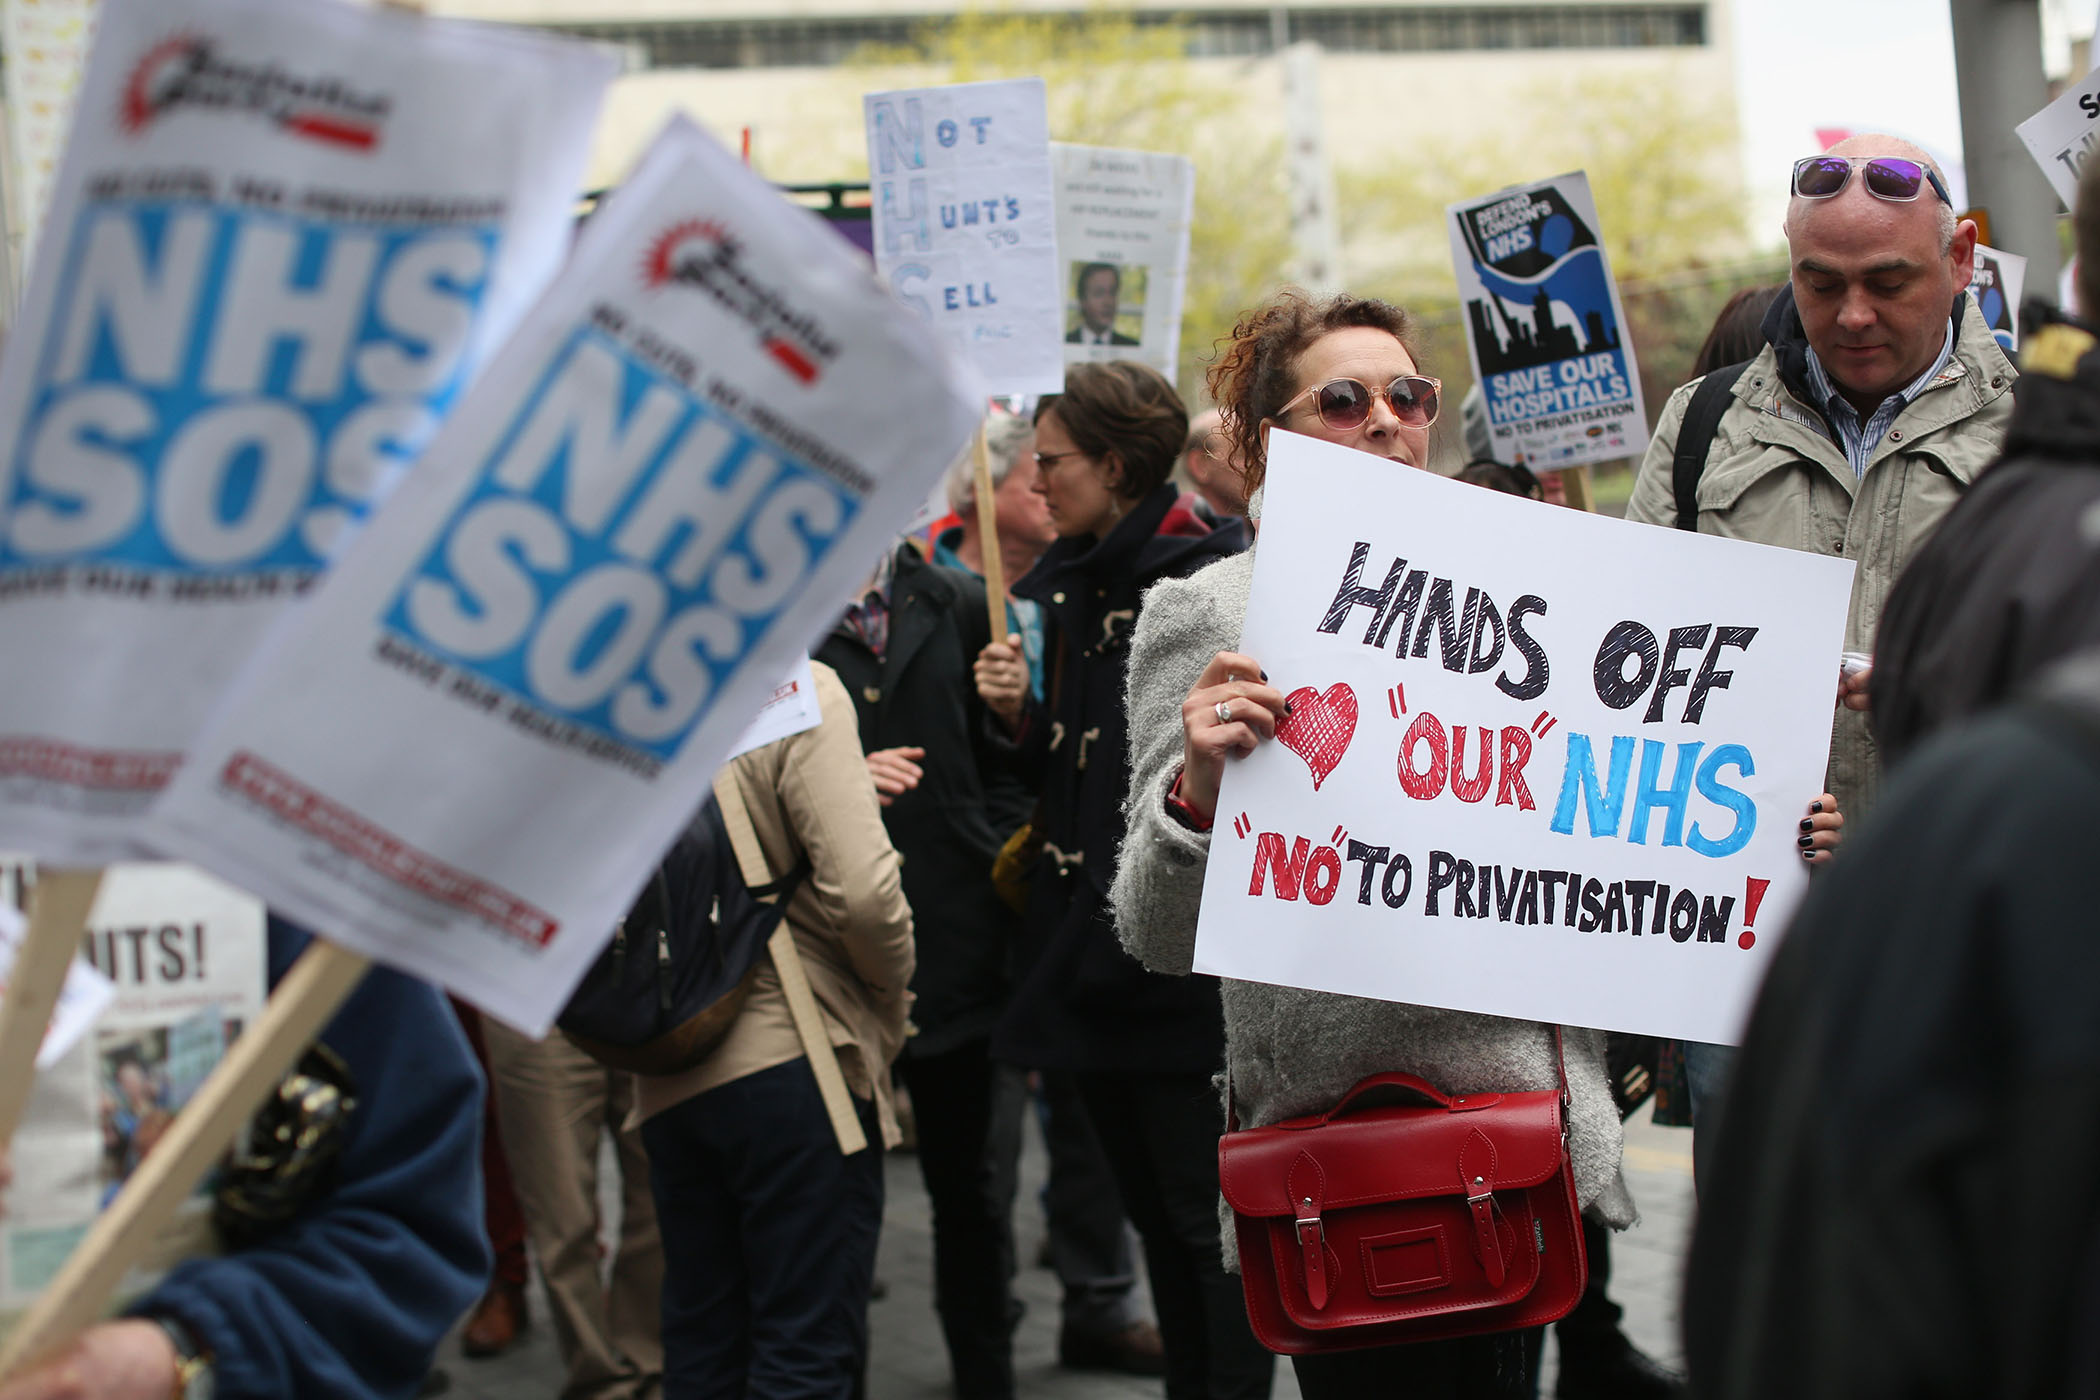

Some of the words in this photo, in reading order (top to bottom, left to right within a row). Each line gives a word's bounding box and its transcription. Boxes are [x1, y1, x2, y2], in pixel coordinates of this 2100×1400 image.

[1476, 193, 1532, 226] DEFEND
[1480, 200, 1552, 240] LONDON'S
[1487, 225, 1533, 262] NHS
[49, 205, 488, 402] NHS
[1492, 365, 1555, 398] SAVE
[1559, 352, 1617, 384] OUR
[1492, 375, 1628, 421] HOSPITALS
[1495, 425, 1513, 438] NO
[1516, 421, 1533, 434] TO
[1535, 401, 1634, 431] PRIVATISATION
[495, 338, 843, 618] NHS
[406, 501, 745, 742] SOS
[1316, 541, 1550, 701] HANDS
[1592, 619, 1760, 724] OFF
[1549, 731, 1758, 858] NHS
[1345, 838, 1413, 909] TO
[1424, 850, 1771, 951] PRIVATISATION!
[82, 921, 207, 984] UTS!
